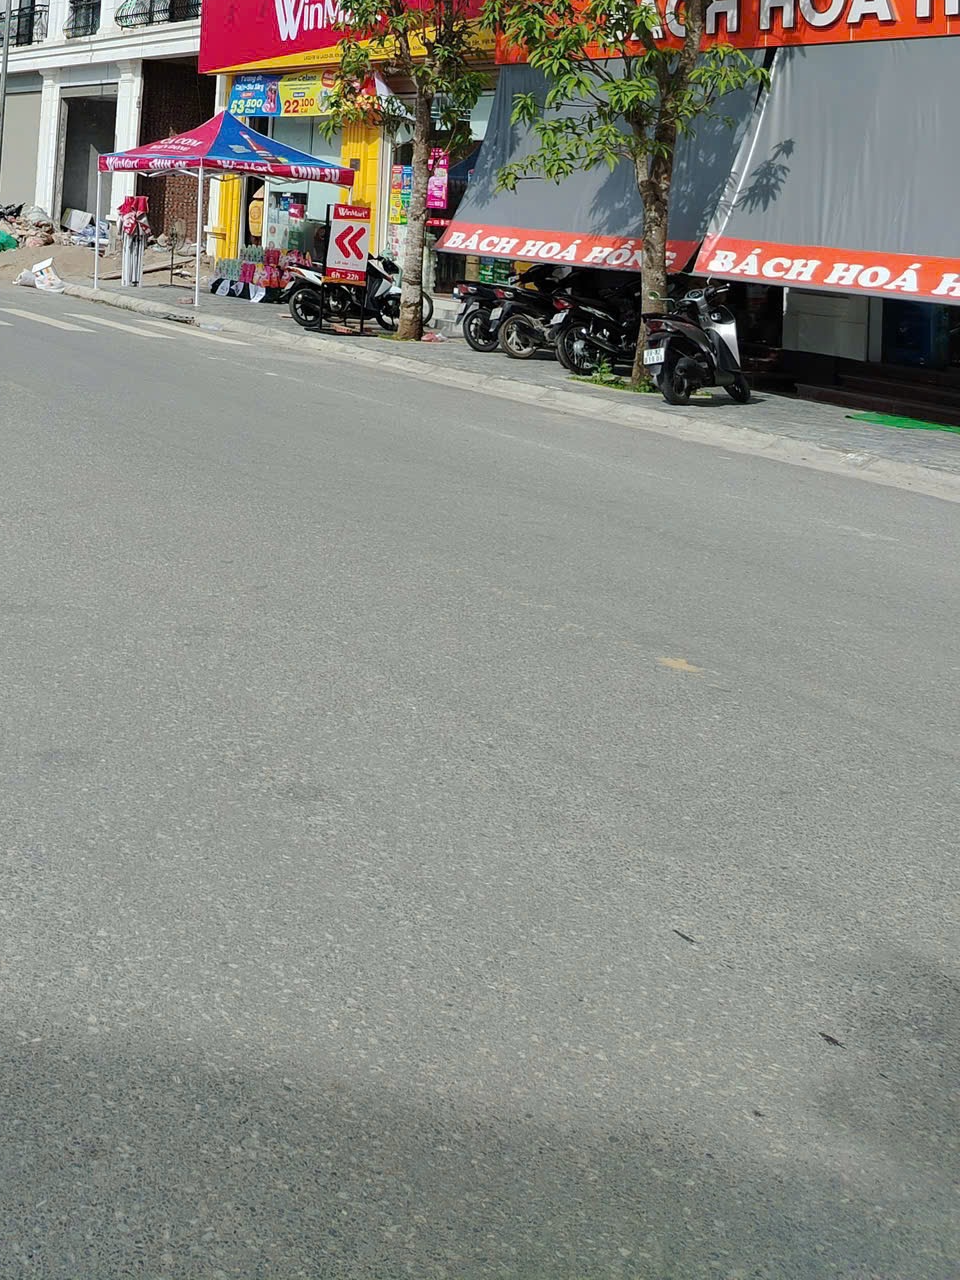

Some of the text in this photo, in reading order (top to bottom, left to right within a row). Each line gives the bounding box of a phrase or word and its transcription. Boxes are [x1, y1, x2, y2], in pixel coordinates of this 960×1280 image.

[106, 156, 140, 170] WinMart
[289, 165, 340, 182] CHIN-SU
[444, 230, 518, 254] BÁCH
[517, 239, 583, 261] HOÁ
[331, 271, 341, 279] 6h
[346, 273, 359, 281] 22h
[707, 248, 822, 283] BÁCH
[823, 262, 922, 293] HOÁ
